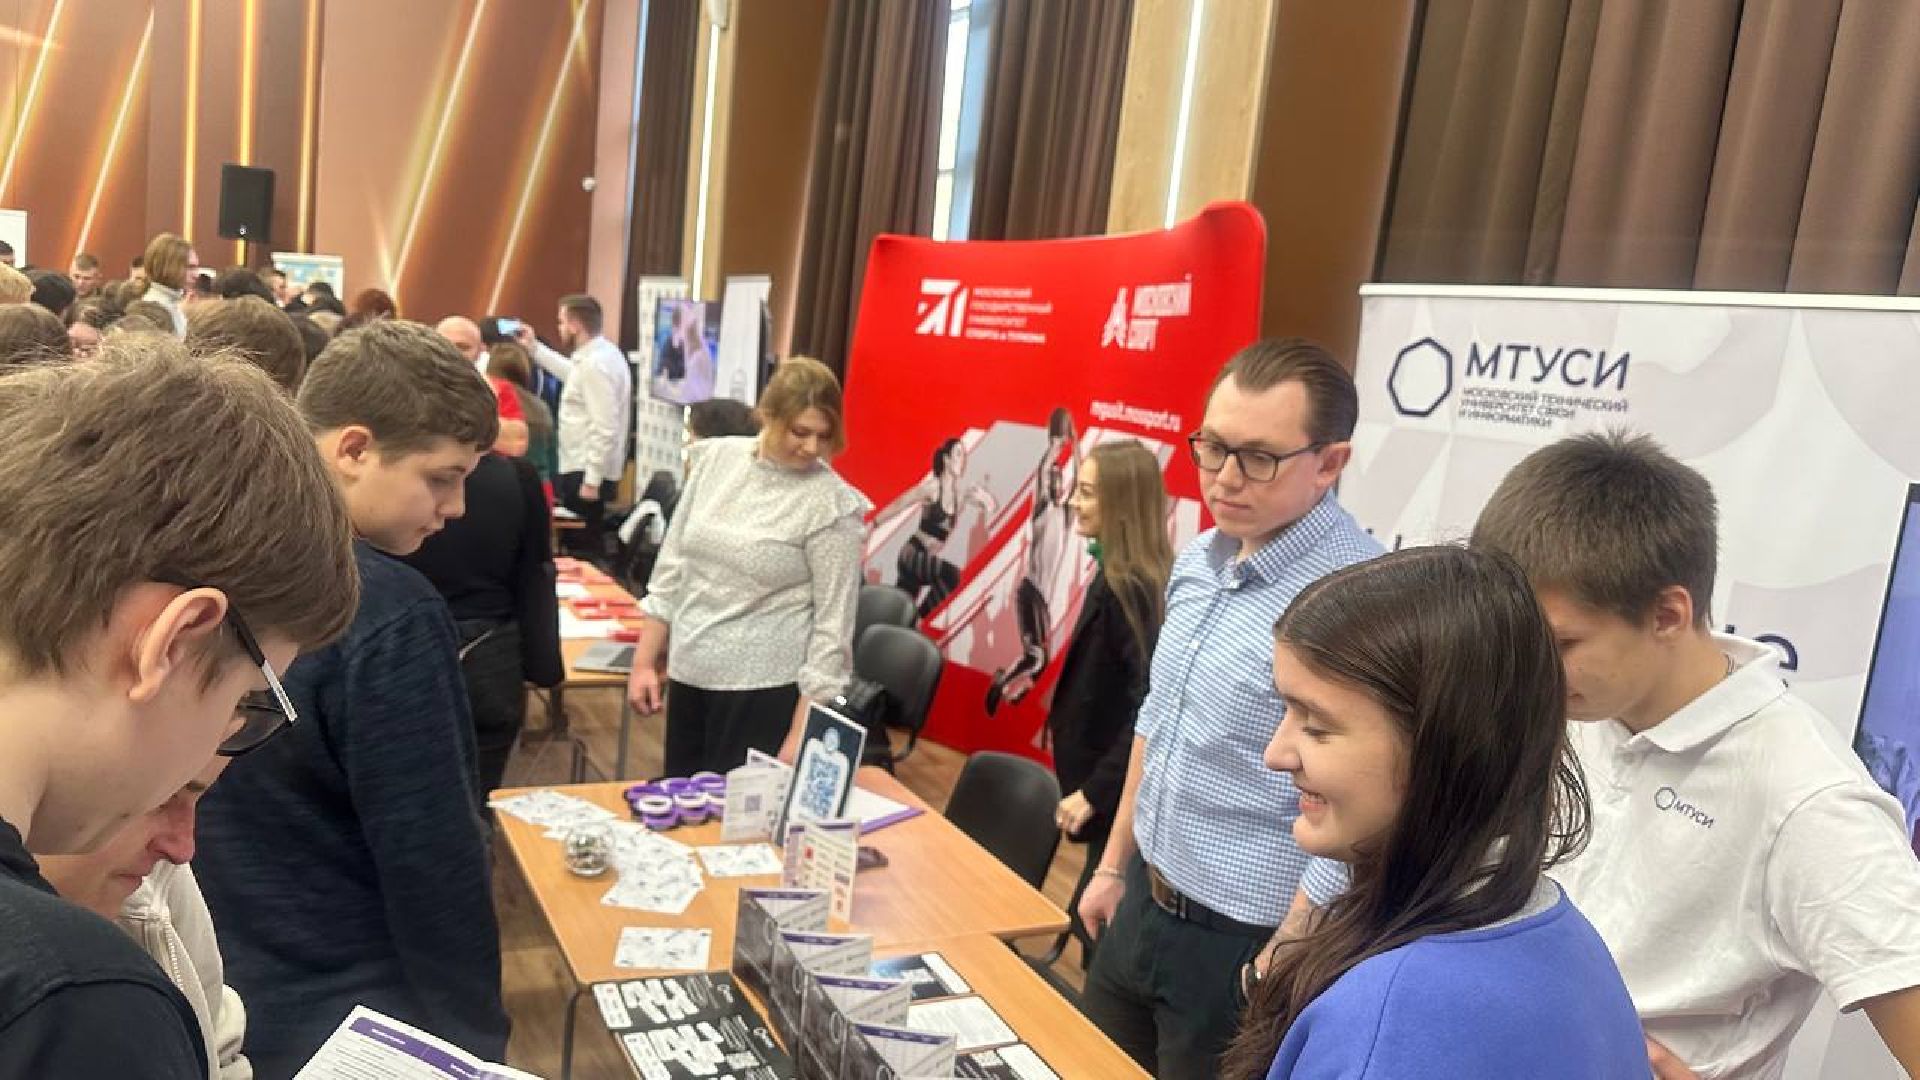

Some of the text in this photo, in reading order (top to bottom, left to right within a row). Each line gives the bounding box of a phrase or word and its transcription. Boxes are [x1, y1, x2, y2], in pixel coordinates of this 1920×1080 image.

[1466, 343, 1630, 391] МТУСИ
[1461, 399, 1533, 412] УНИВЕРСИТЕТ
[1464, 387, 1628, 411] МОСКОВСКИЙ ТЕХНИЧЕСКИЙ
[1674, 801, 1714, 828] МТУСИ
